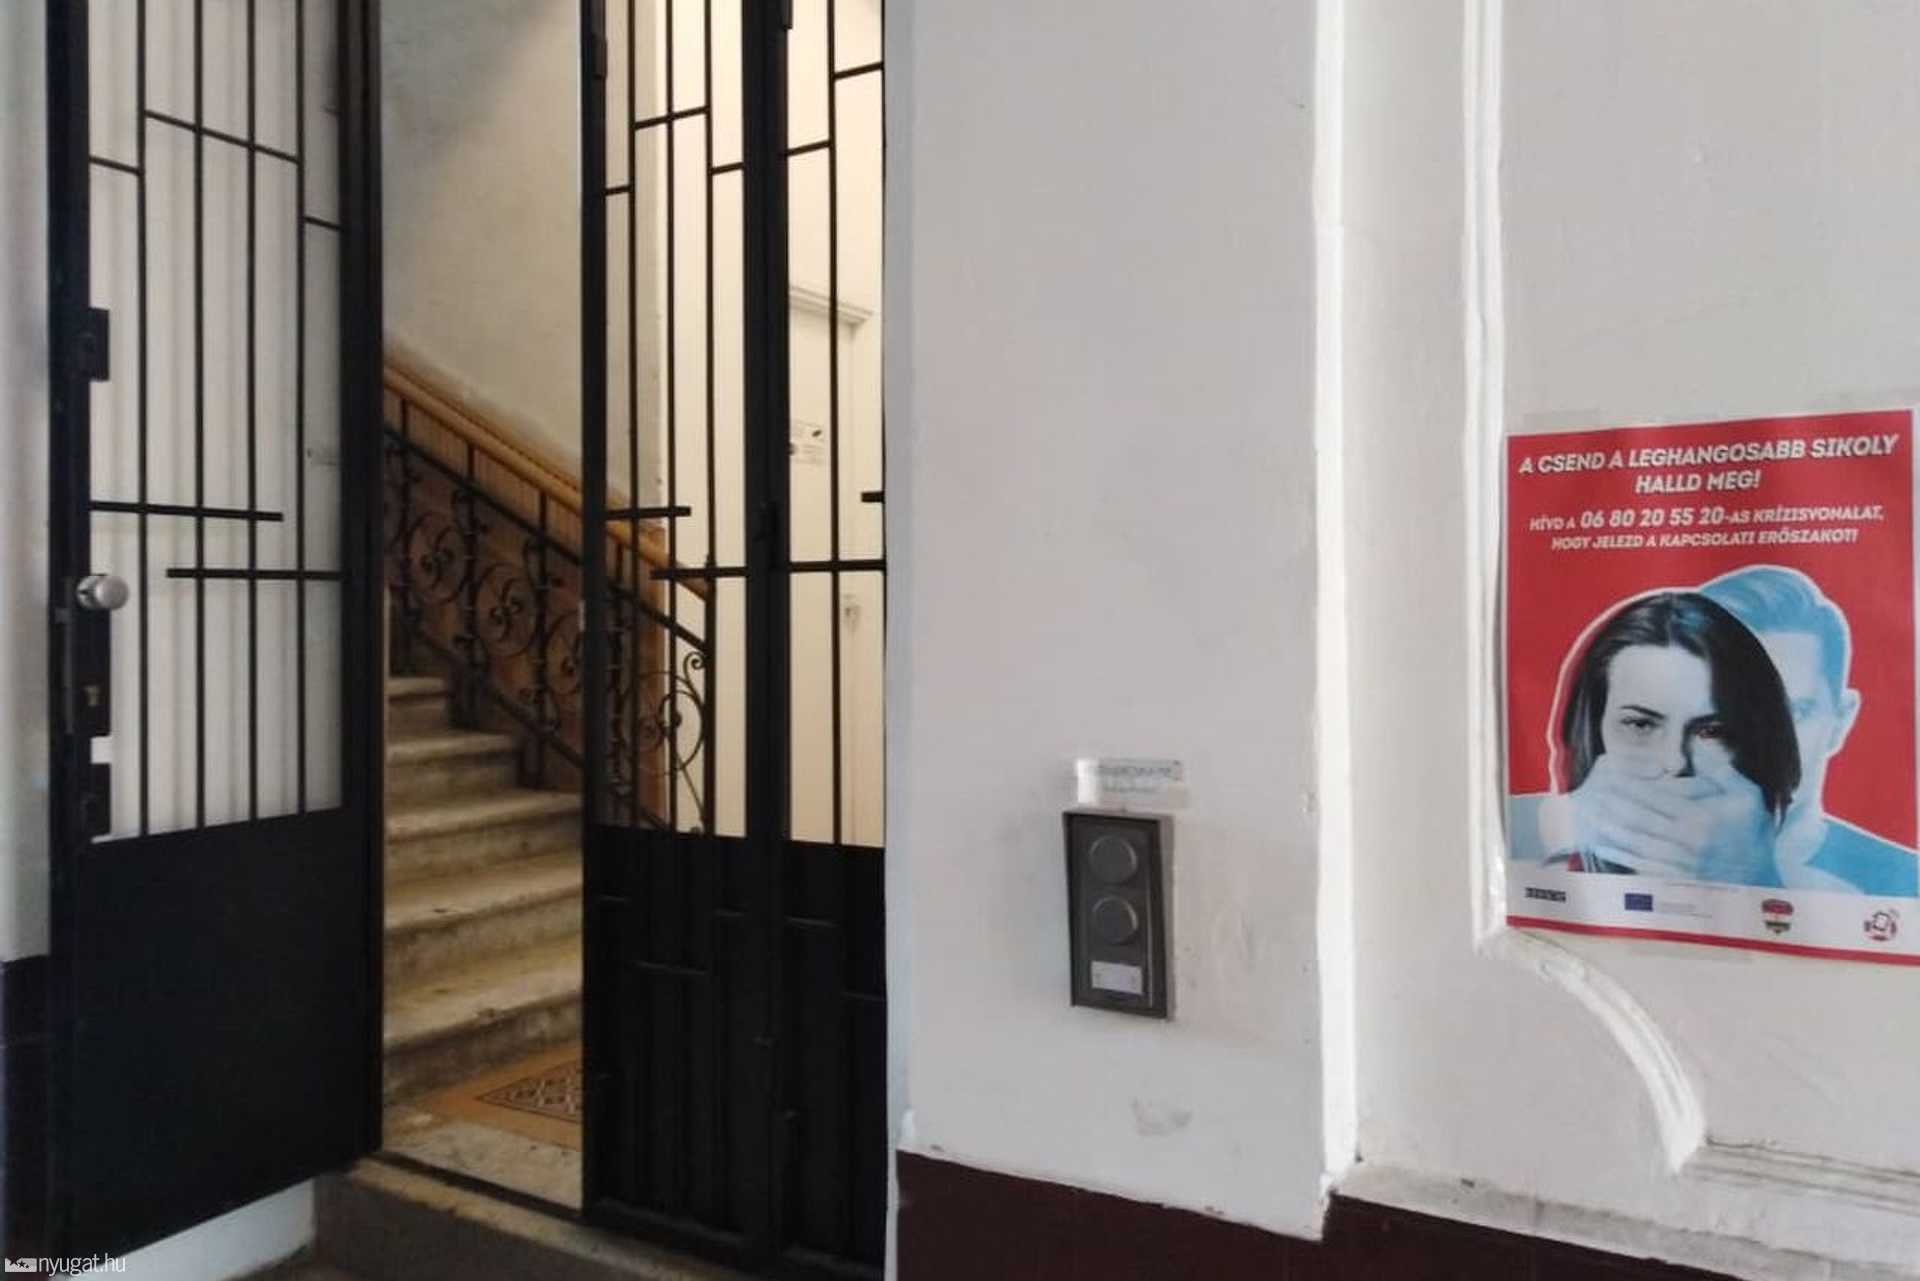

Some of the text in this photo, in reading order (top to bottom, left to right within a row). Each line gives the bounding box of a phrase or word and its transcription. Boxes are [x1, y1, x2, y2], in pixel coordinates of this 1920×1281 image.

[1518, 433, 1899, 474] A CSEND A LEGHANGOSABB SIKOLY
[1634, 469, 1761, 494] HALLD MEG!
[1565, 518, 1576, 530] A
[1580, 510, 1605, 528] 06
[1609, 509, 1636, 528] 80
[1640, 508, 1665, 527] 20
[1669, 507, 1695, 526] 55
[1551, 536, 1592, 550] HOGY
[1592, 534, 1644, 549] JELEZD
[1645, 535, 1657, 547] A
[1659, 530, 1754, 547] KAPCSOLATI
